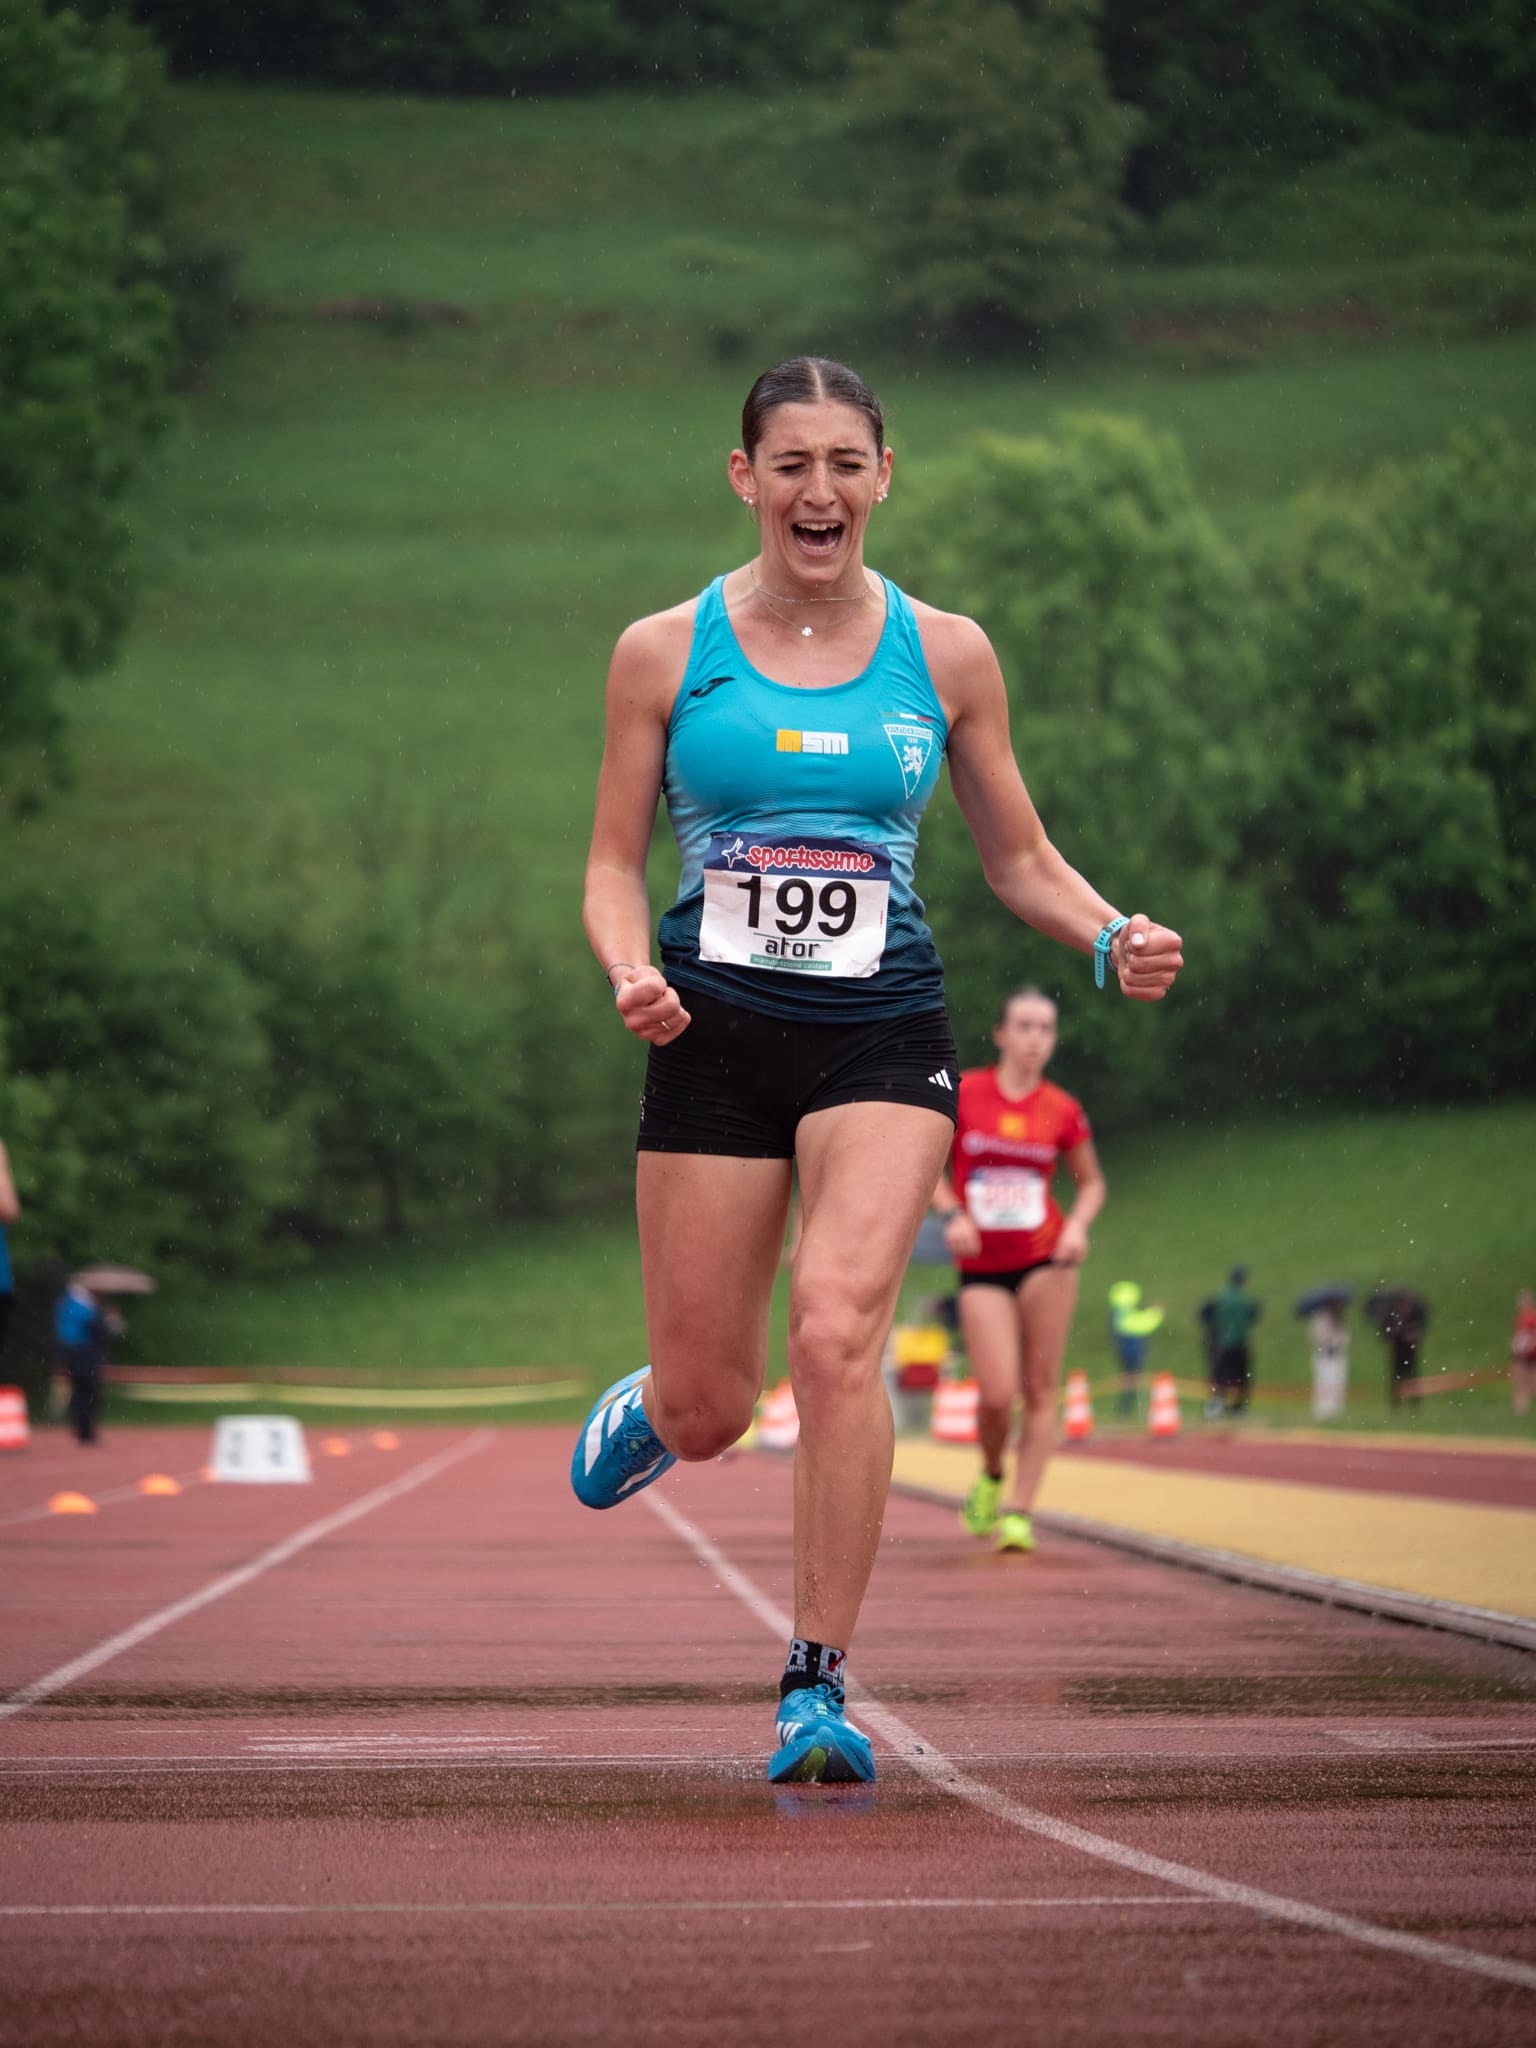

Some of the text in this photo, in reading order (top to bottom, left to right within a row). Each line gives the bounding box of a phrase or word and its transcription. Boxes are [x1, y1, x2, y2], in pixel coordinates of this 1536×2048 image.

[746, 845, 875, 872] sportissimo
[737, 875, 857, 937] 199
[765, 937, 821, 958] ator
